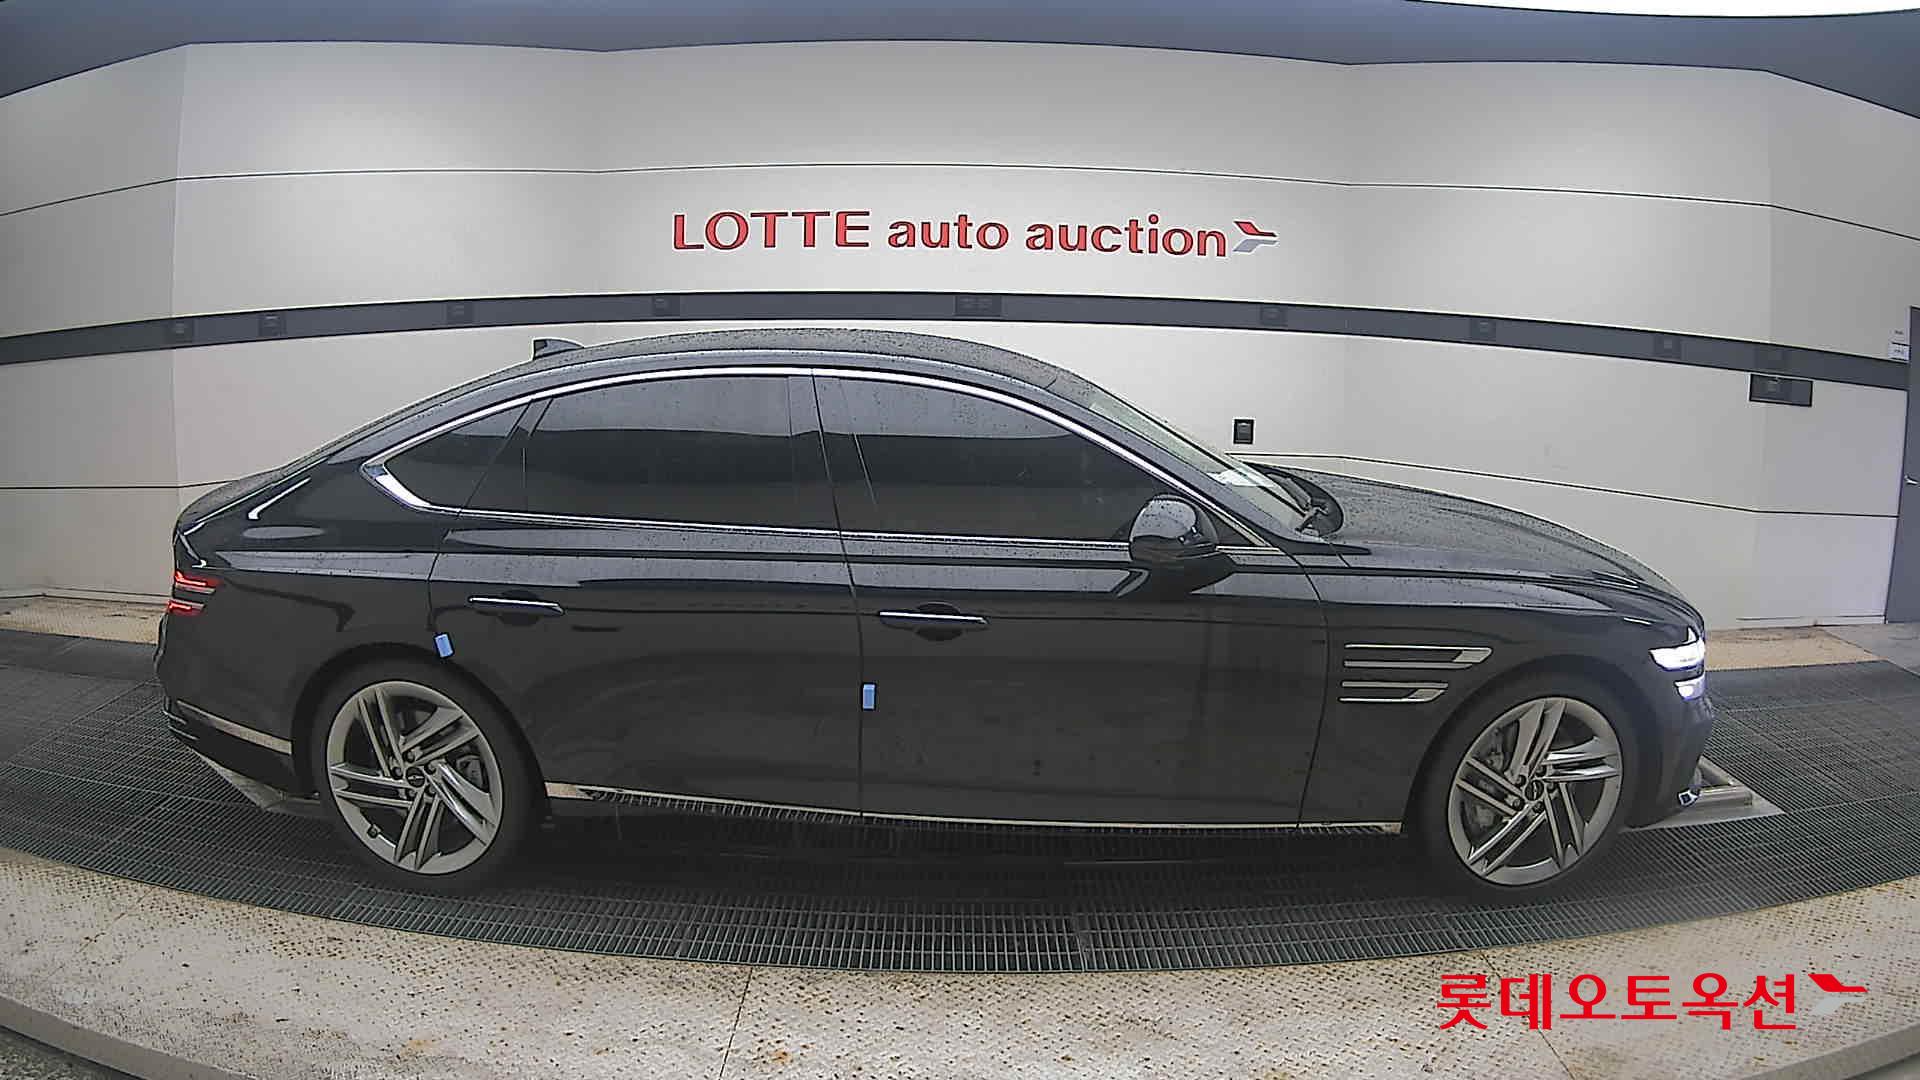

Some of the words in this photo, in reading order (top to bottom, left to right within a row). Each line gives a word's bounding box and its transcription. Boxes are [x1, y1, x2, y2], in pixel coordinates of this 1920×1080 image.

[673, 210, 870, 250] LOTTE
[887, 213, 1009, 249] auto
[1025, 214, 1227, 257] auction
